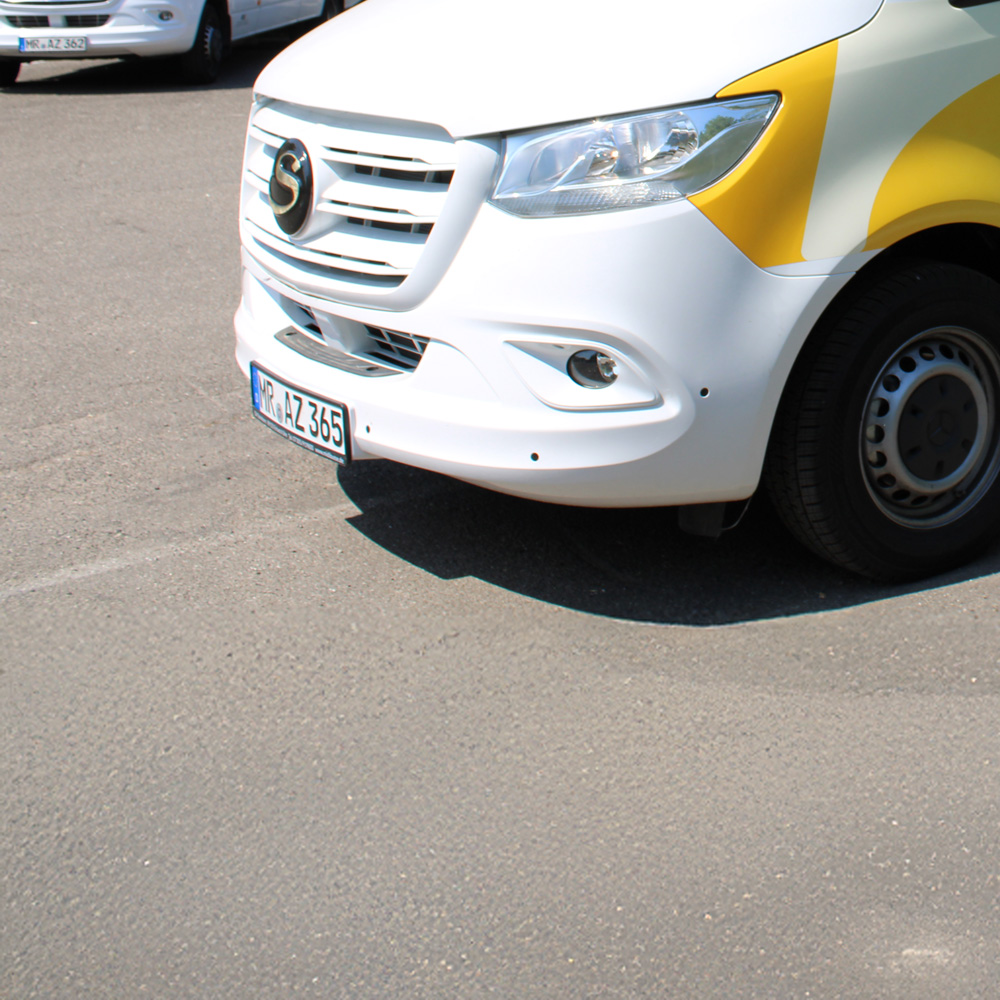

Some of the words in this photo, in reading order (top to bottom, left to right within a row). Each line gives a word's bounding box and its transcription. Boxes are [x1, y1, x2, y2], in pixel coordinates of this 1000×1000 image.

[63, 39, 84, 49] 362
[258, 373, 277, 418] MR
[284, 390, 306, 434] AZ
[307, 399, 344, 448] 365
